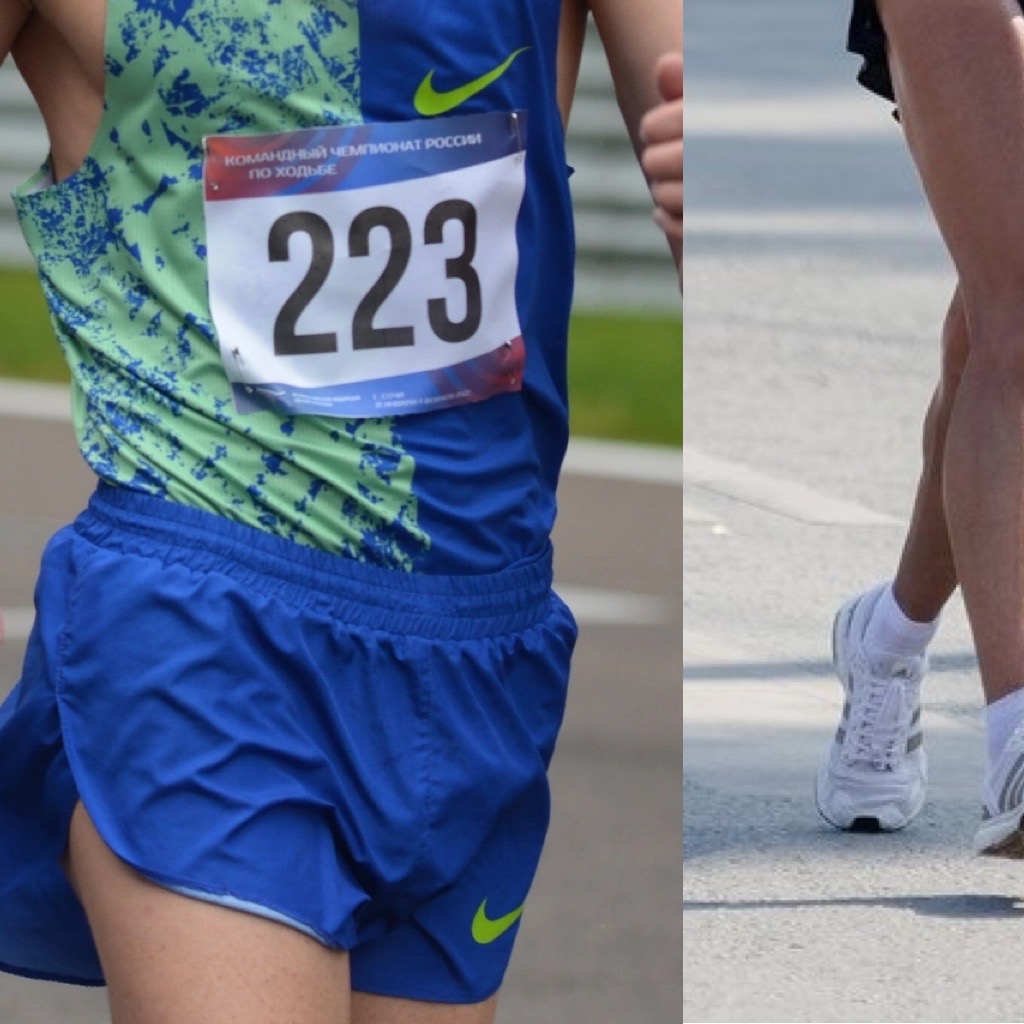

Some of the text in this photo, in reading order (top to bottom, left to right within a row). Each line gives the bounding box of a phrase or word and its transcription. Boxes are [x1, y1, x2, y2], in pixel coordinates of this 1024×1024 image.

[224, 133, 482, 167] КОМАНДНЫЙ ЧЕМПИОНАТ РОССИИ
[249, 164, 337, 179] ПО ХОДЬБЕ
[268, 198, 482, 356] 223
